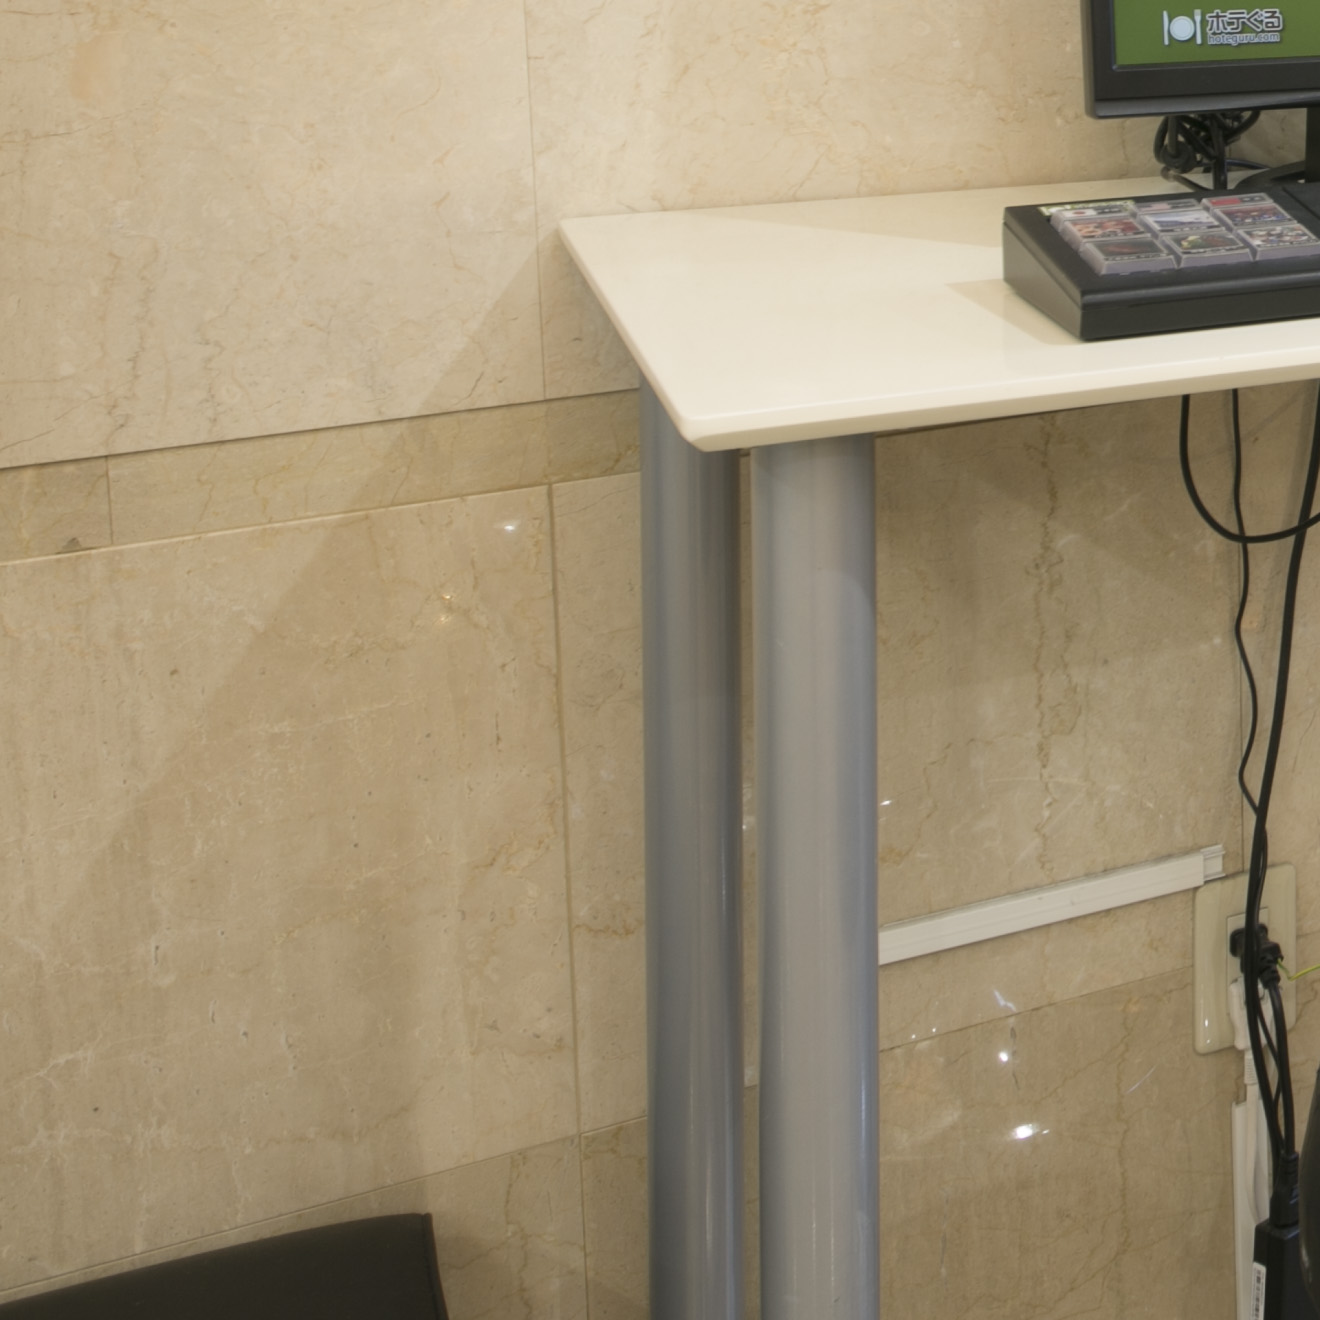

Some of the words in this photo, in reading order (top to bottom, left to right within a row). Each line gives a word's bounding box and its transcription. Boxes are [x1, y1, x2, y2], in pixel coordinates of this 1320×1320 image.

[1206, 8, 1284, 33] ホテぐる
[1207, 32, 1280, 46] hoteguru.com
